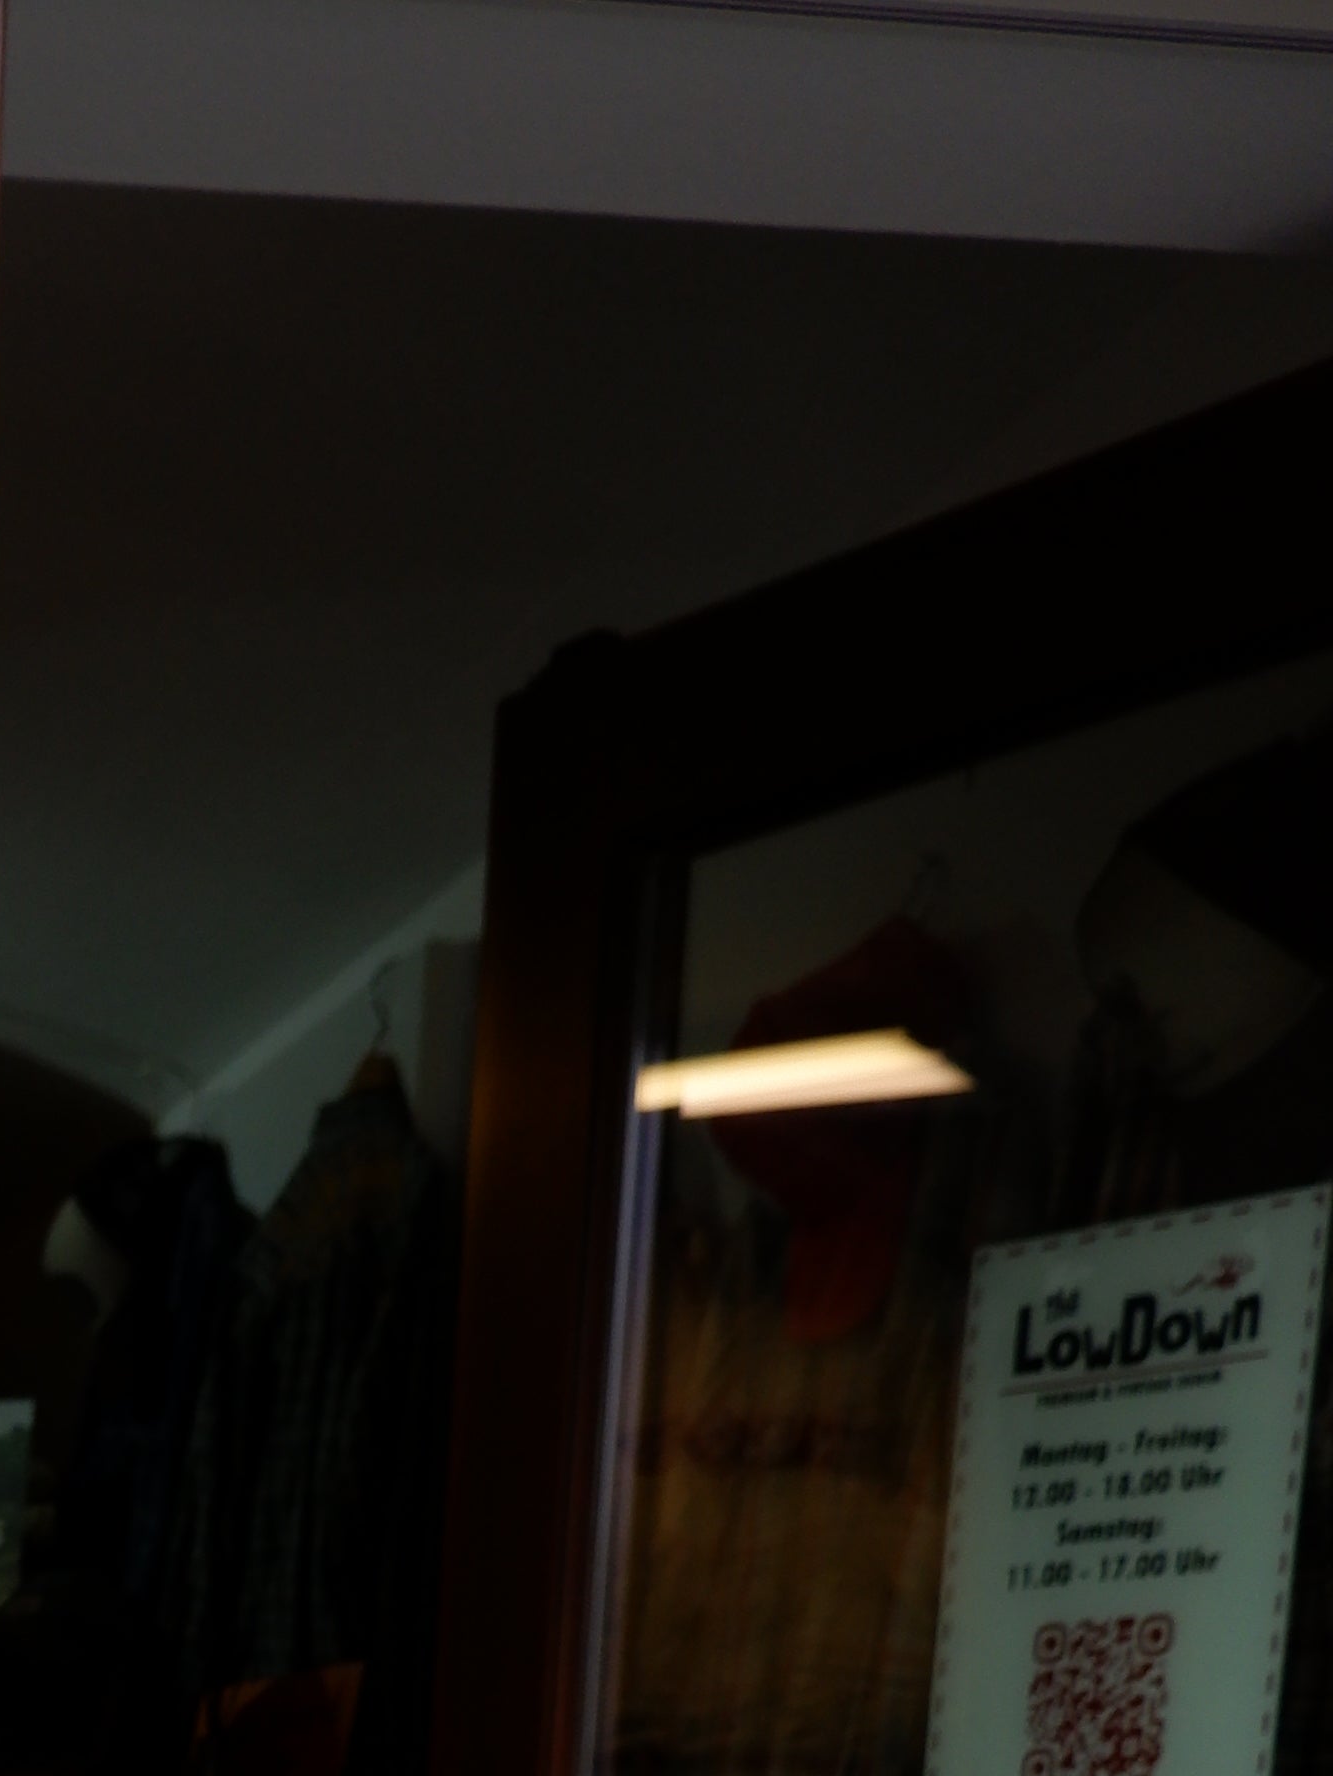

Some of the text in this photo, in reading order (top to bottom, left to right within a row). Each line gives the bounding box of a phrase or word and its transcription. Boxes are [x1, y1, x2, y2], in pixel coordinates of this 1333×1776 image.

[1015, 1292, 1261, 1375] LowDown
[1020, 1440, 1109, 1469] Montag
[1134, 1425, 1229, 1455] Freitag:
[1181, 1459, 1225, 1492] Uhr
[1175, 1545, 1221, 1576] Uhr
